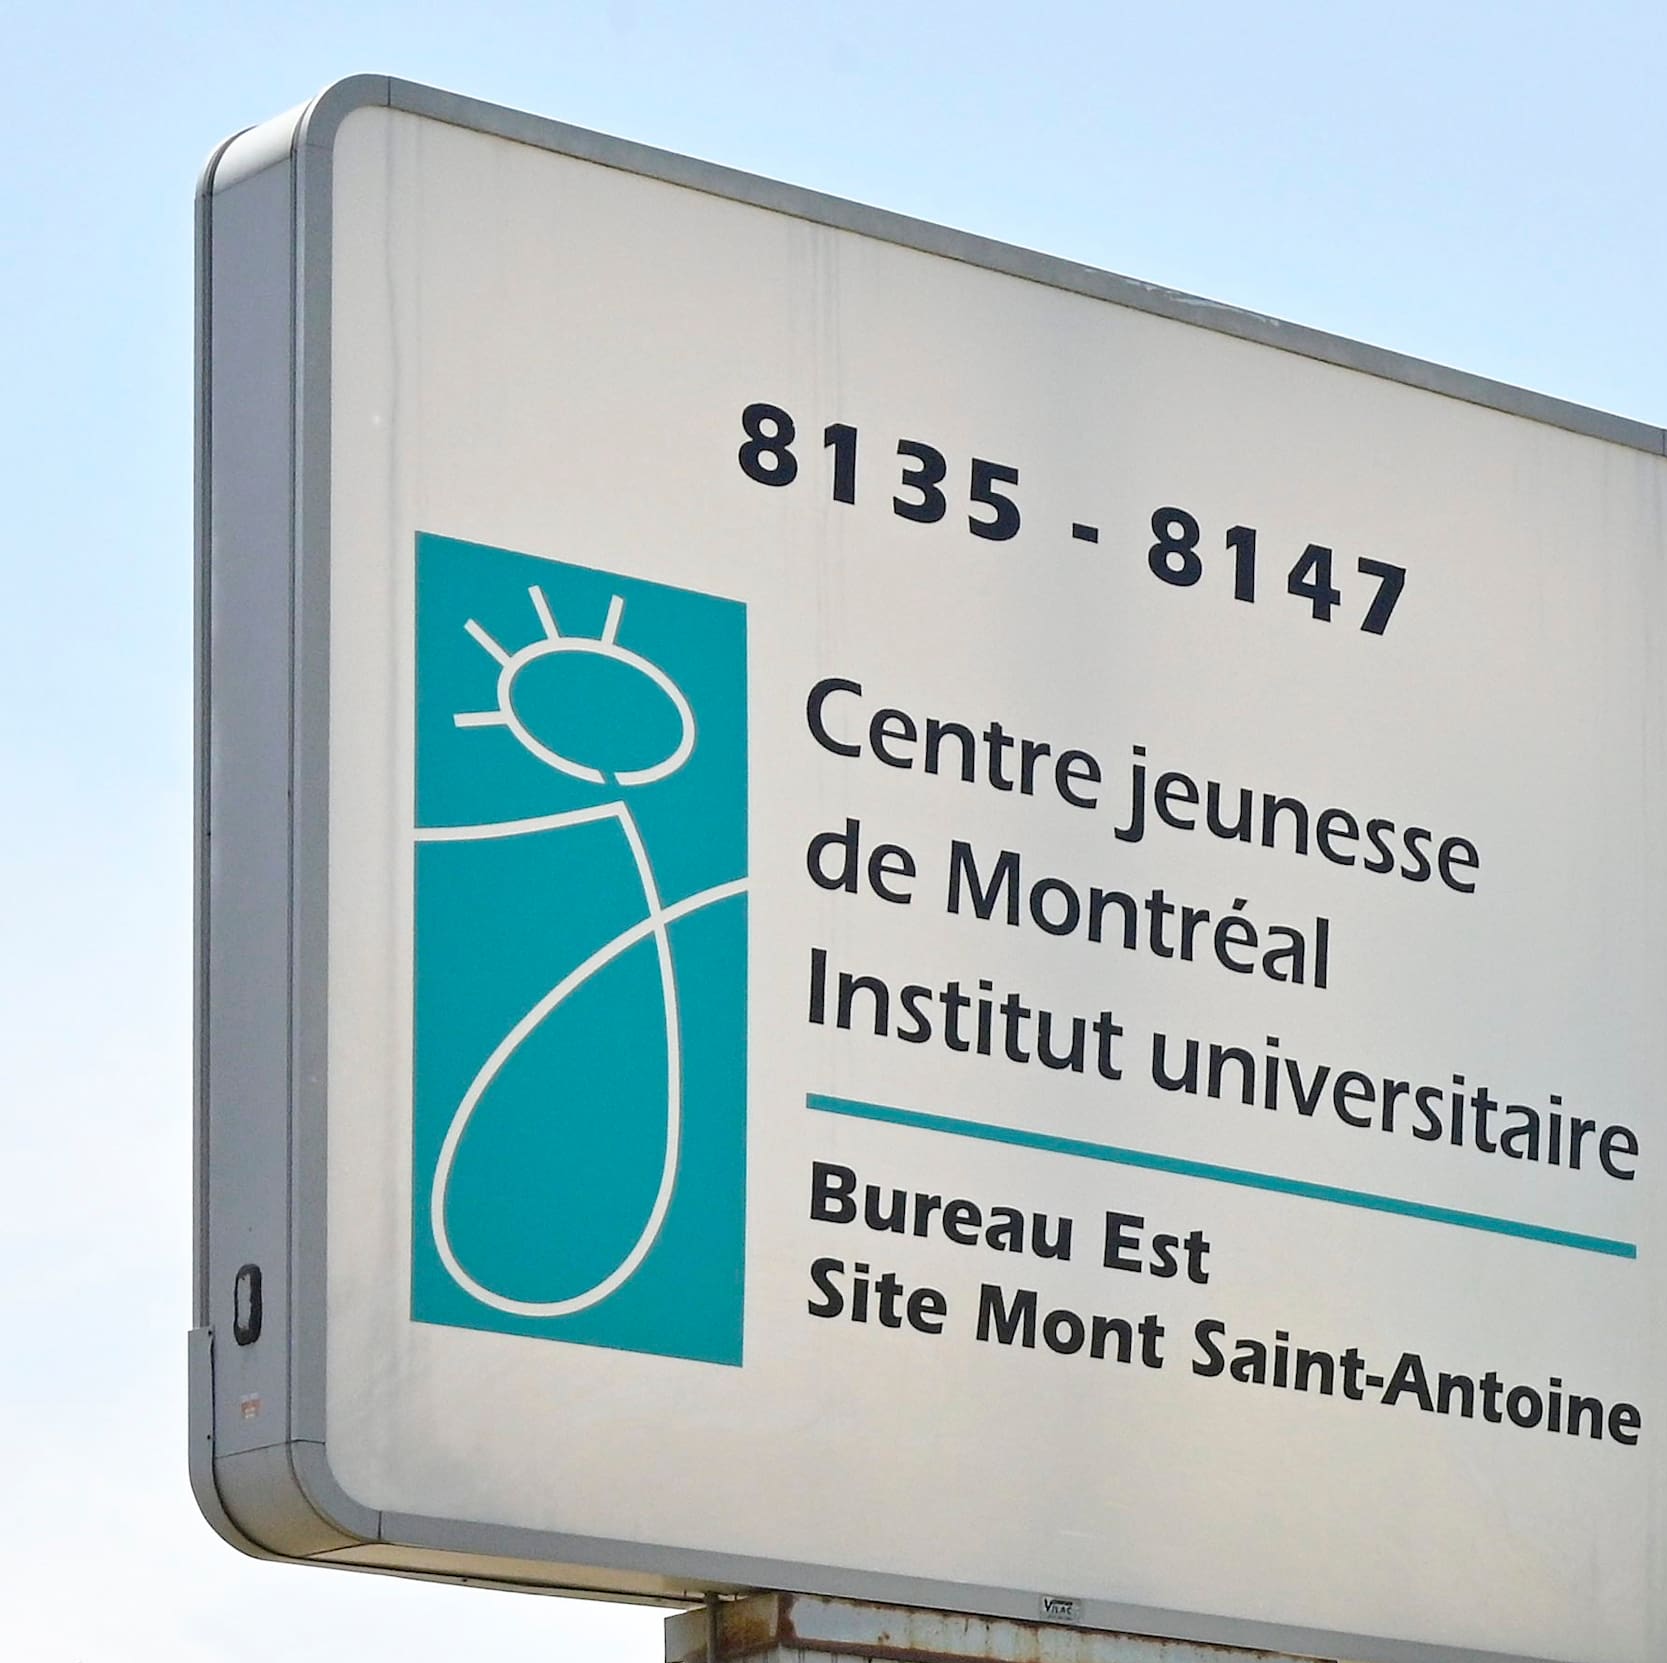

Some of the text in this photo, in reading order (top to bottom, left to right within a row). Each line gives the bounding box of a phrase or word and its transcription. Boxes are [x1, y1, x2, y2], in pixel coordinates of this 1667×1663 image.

[738, 402, 1021, 542] 8135
[1147, 506, 1407, 636] 8147
[806, 677, 1480, 894] Centre jeunesse
[806, 817, 1329, 990] de Montréal
[808, 947, 1639, 1181] Institut universitaire
[810, 1161, 1210, 1285] Bureau Est
[807, 1257, 1642, 1446] Site Mont Saint-Antoine
